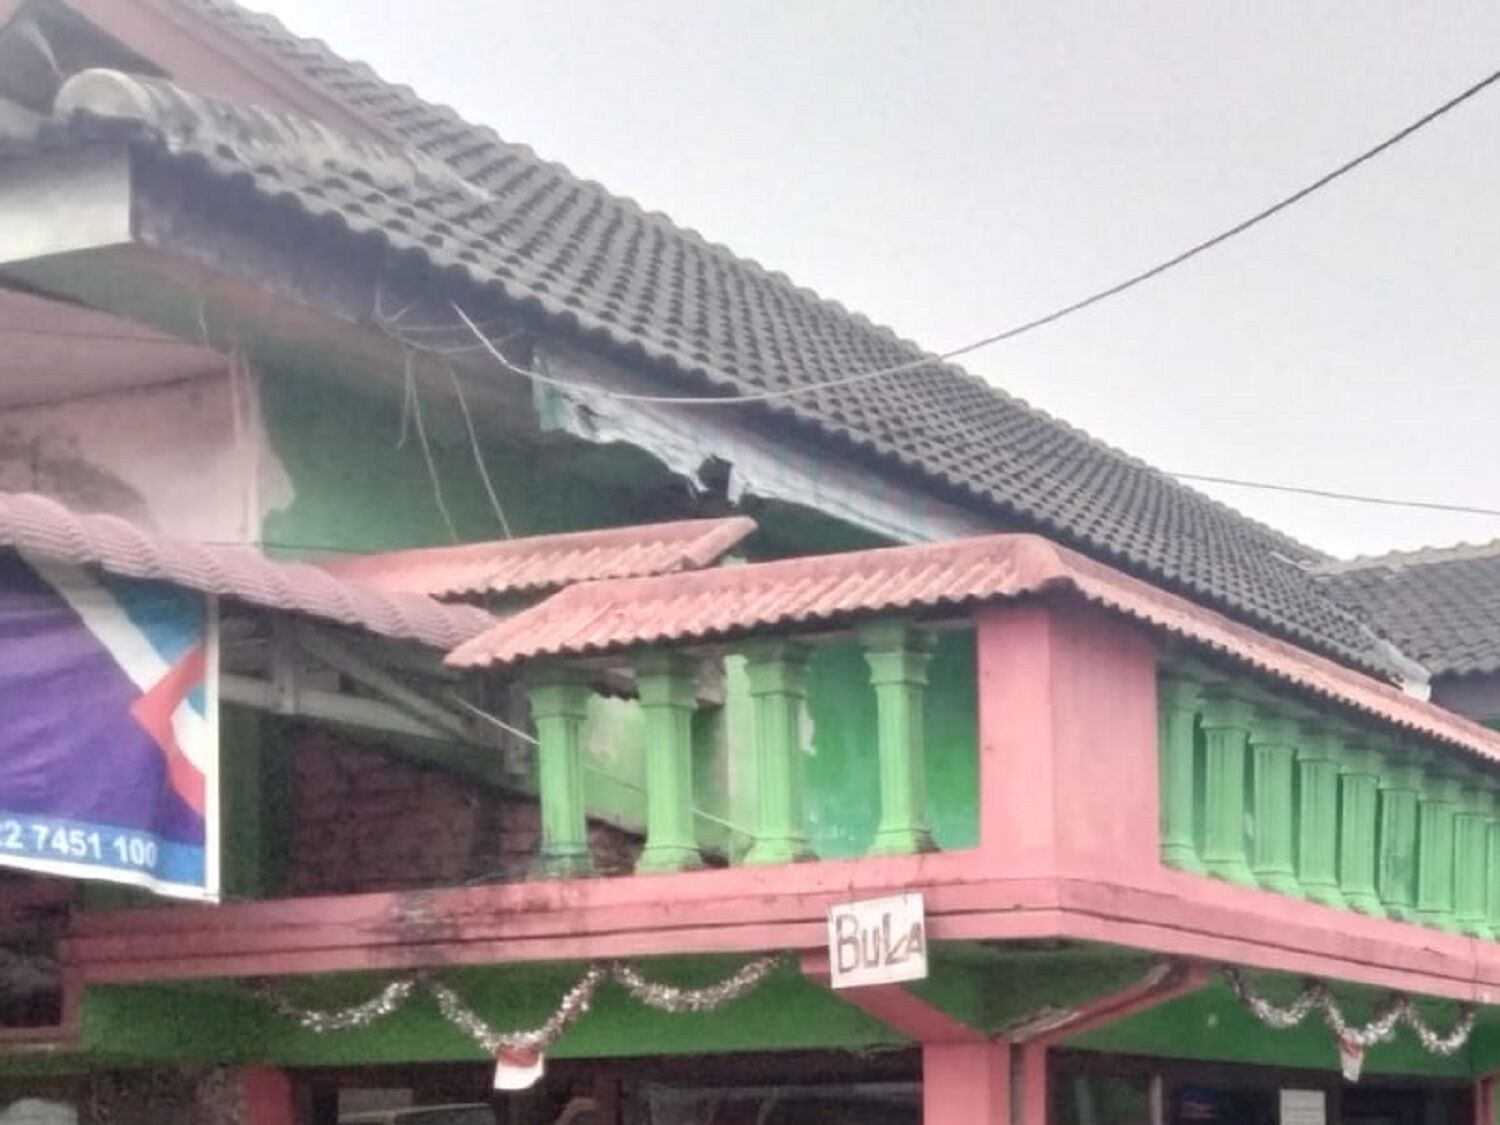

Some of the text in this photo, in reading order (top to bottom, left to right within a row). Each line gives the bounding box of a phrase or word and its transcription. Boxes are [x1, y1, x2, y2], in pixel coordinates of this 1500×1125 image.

[0, 820, 157, 868] 2 7451 100
